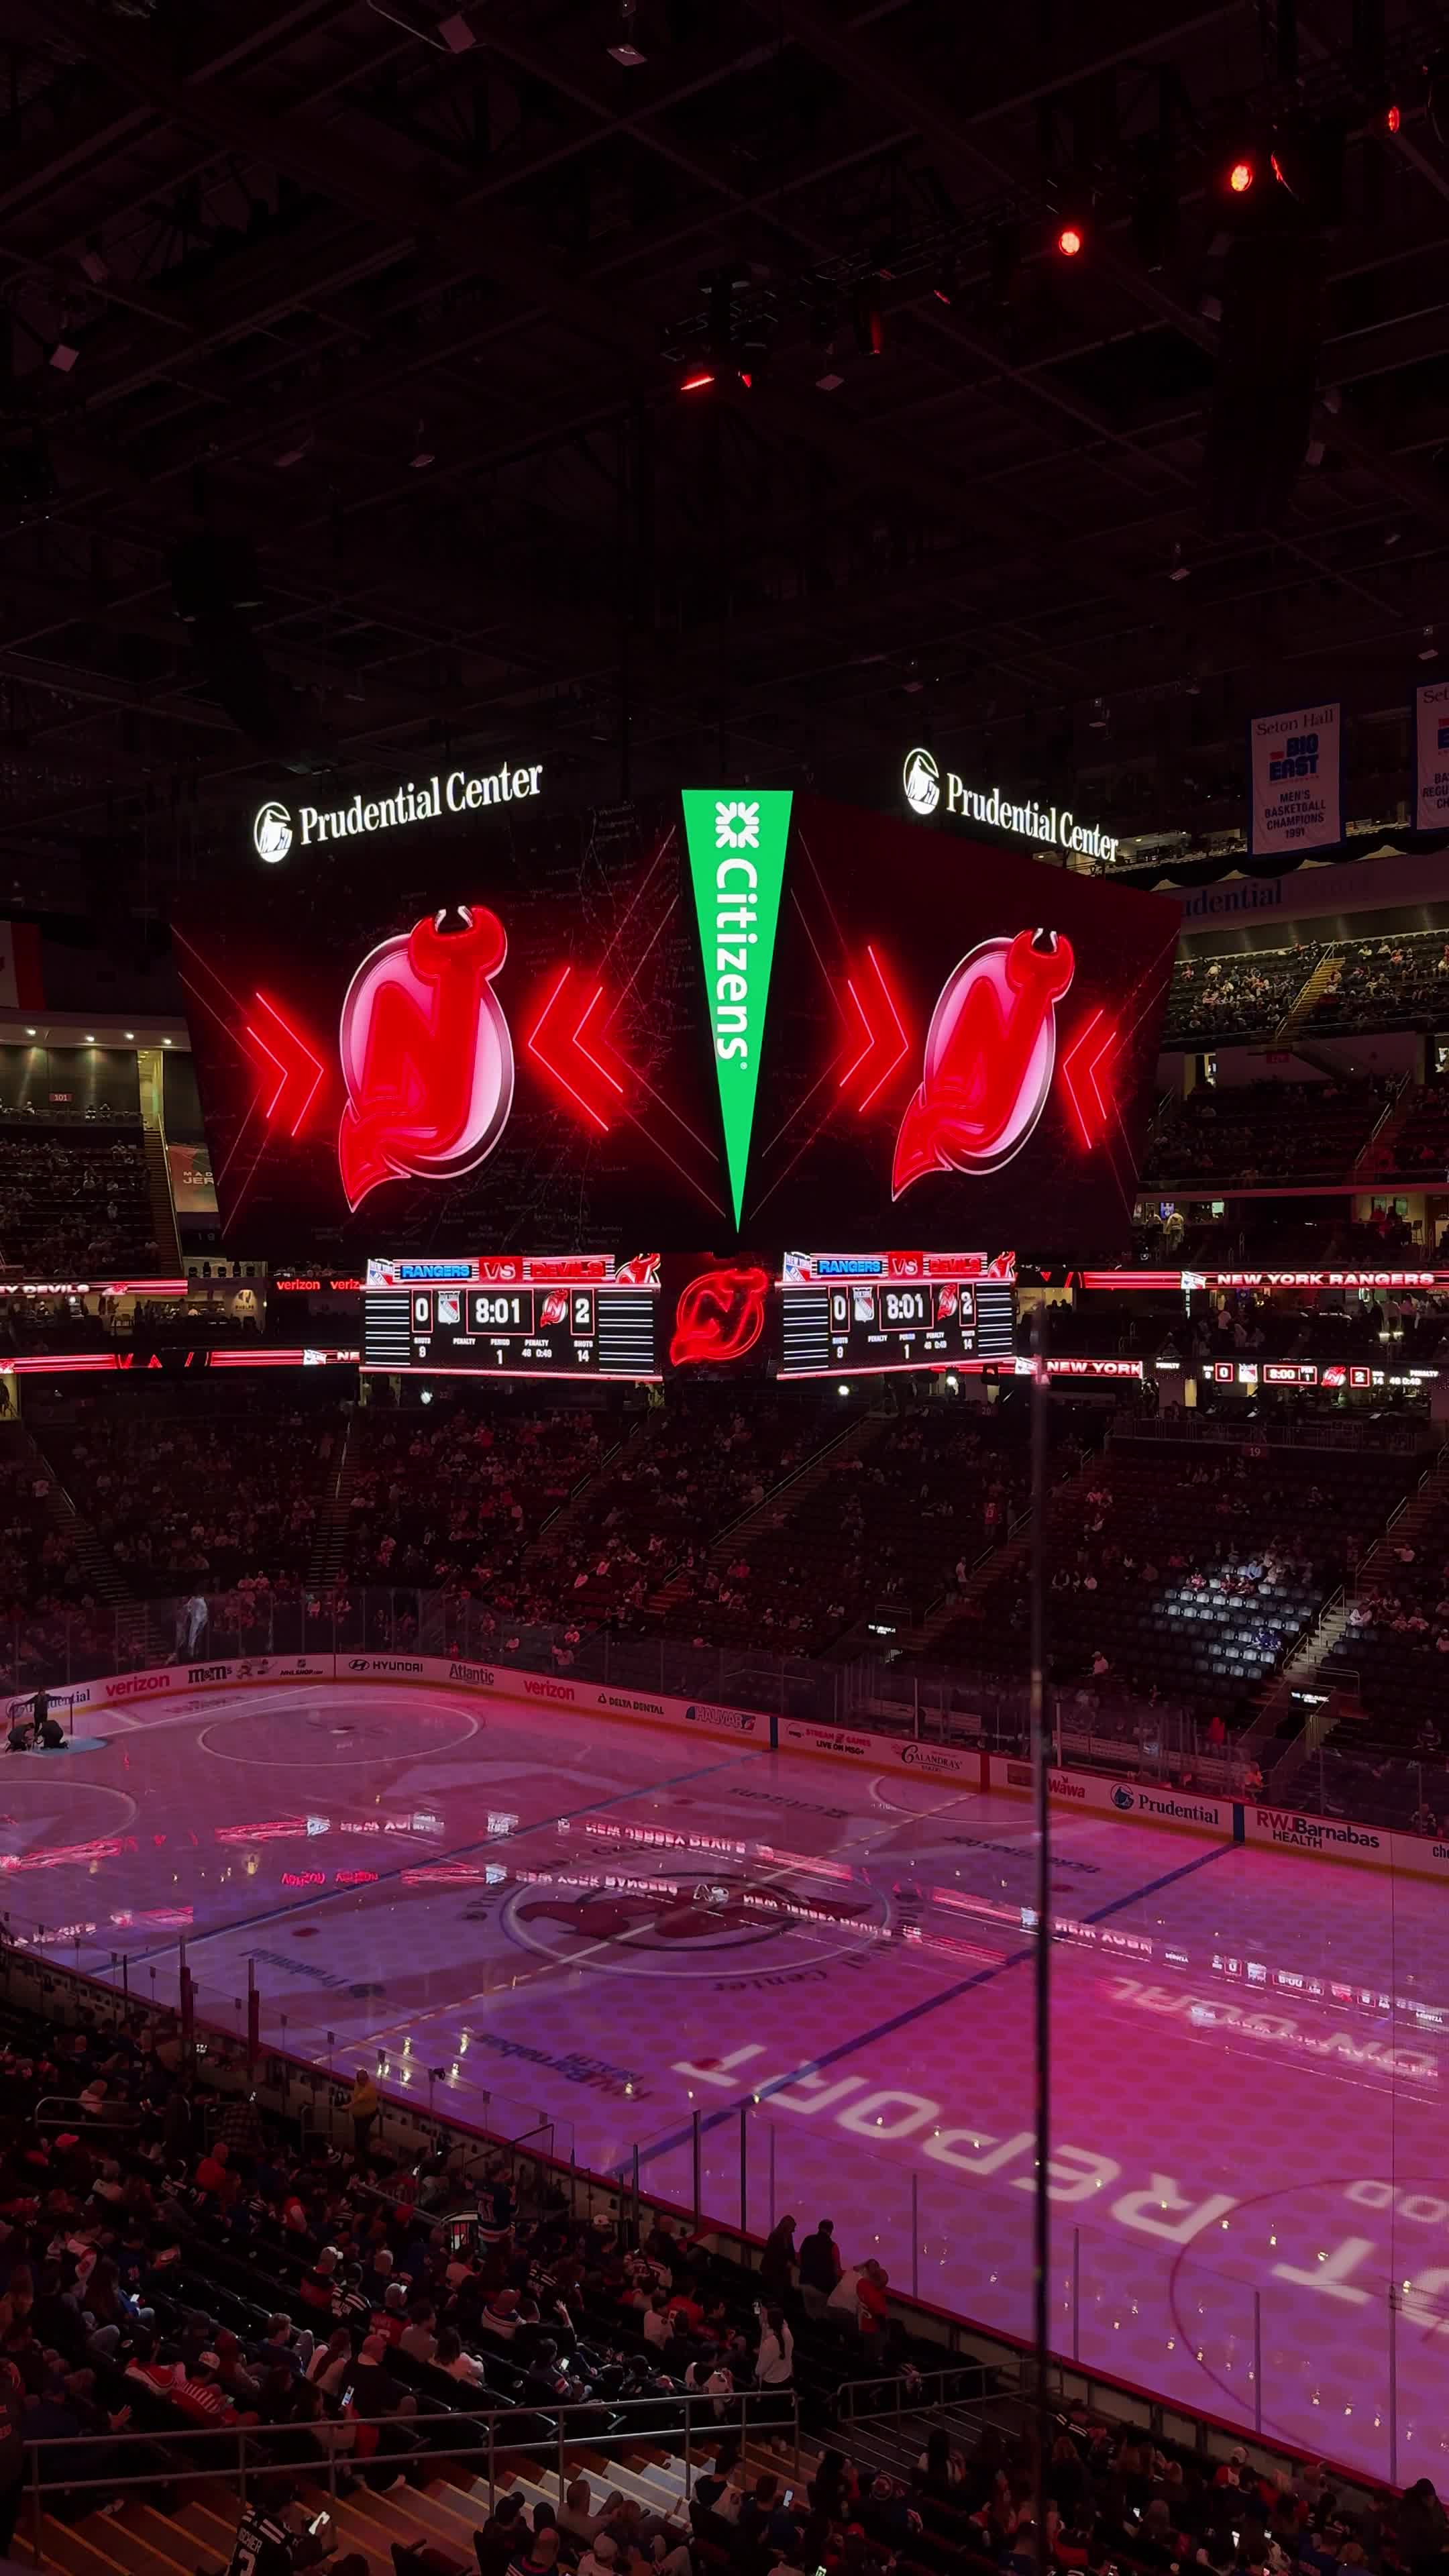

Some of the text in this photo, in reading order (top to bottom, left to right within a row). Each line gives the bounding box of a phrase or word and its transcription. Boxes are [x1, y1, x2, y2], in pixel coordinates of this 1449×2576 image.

[1256, 708, 1334, 736] Seton Hall
[1269, 754, 1319, 782] EAST
[299, 762, 544, 846] Prudential Center
[1280, 790, 1310, 803] MEN'S
[946, 773, 1119, 863] Prudential Center
[1265, 800, 1326, 818] BASKETBALL
[1267, 812, 1325, 830] CHAMPIONS
[715, 858, 758, 1060] Citizens
[402, 1260, 604, 1279] RANGERS VS DEVILS
[820, 1260, 881, 1273] RANGERS
[892, 1258, 918, 1276] VS
[930, 1258, 981, 1272] DEVILS
[276, 1279, 321, 1290] verizon
[1218, 1273, 1435, 1285] NEW YORK RANGERS
[23, 1284, 90, 1294] DEVILS
[415, 1297, 429, 1322] 0
[475, 1297, 520, 1324] 8:01
[575, 1298, 590, 1323] 2
[834, 1295, 846, 1320] 0
[886, 1293, 924, 1320] 8:01
[961, 1291, 973, 1315] 2
[525, 1339, 549, 1347] PENALTY
[904, 1344, 910, 1359] 1
[963, 1339, 973, 1350] 14
[496, 1349, 503, 1364] 1
[577, 1350, 590, 1362] 14
[1047, 1361, 1140, 1375] NEW YORK
[1219, 1367, 1228, 1379] 0
[1269, 1369, 1295, 1381] 8:00
[1355, 1371, 1364, 1383] 2
[1250, 1447, 1261, 1456] 19
[373, 1661, 423, 1672] HYUNDAI
[449, 1664, 494, 1683] Atlantic
[106, 1675, 170, 1697] verizon
[524, 1680, 575, 1701] verizon
[609, 1697, 665, 1715] DELTA DENTAL
[806, 1729, 835, 1739] STREAM
[816, 1740, 865, 1755] LIVE ON MSG+
[1048, 1776, 1085, 1799] Wawa
[1138, 1794, 1219, 1825] Prudential
[1256, 1811, 1380, 1848] RWJBarnabas
[1273, 1830, 1323, 1849] HEALTH
[672, 2043, 1240, 2245] REPORT
